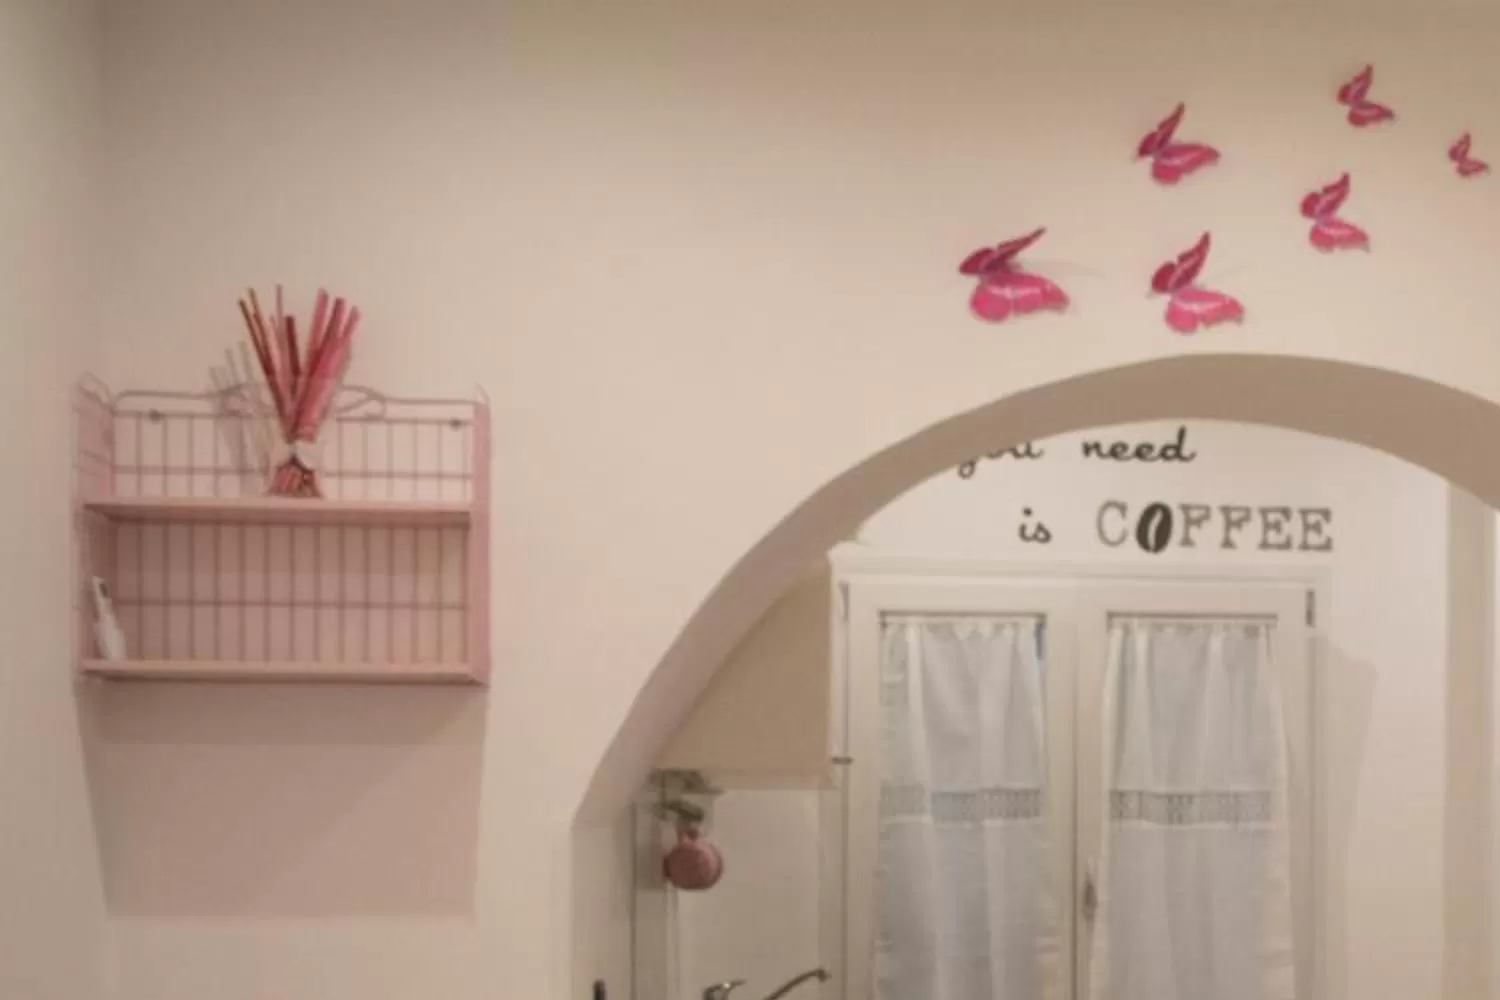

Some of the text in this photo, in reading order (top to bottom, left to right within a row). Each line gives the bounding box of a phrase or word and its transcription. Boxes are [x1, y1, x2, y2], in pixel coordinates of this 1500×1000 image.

[1081, 426, 1197, 463] need
[1018, 501, 1334, 553] is COFFEE
